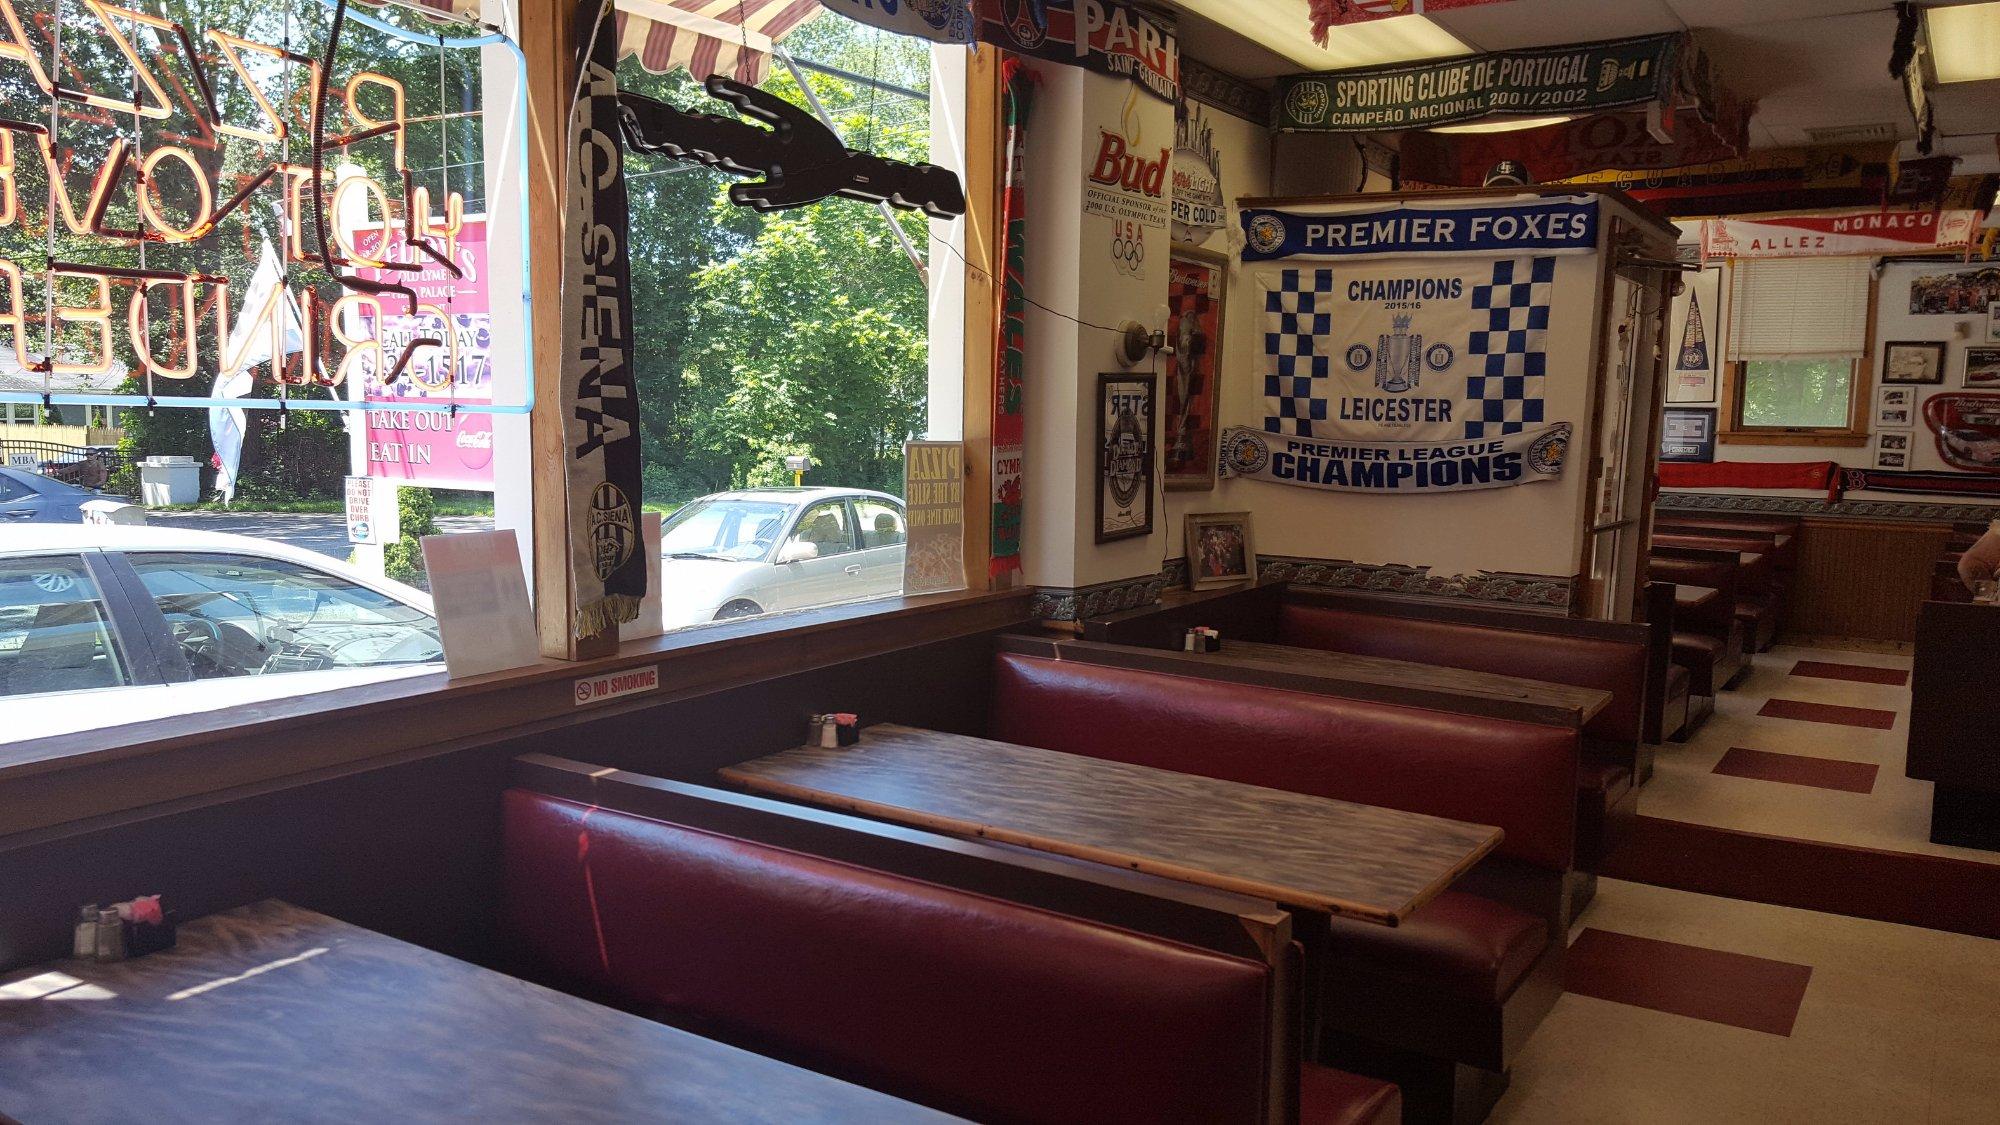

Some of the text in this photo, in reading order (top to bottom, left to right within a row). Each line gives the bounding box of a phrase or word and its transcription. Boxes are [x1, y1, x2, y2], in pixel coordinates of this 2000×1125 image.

[1106, 52, 1174, 100] SAINT-GERMAIN
[1337, 74, 1415, 107] SPORTING
[1418, 65, 1471, 100] CLUBE
[1473, 59, 1497, 91] DE
[1498, 53, 1590, 87] PORTUGAL
[1332, 107, 1404, 125] CAMPEÃO
[1409, 97, 1484, 120] NACIONAL
[1489, 88, 1588, 107] 2001/2002
[1089, 127, 1173, 198] Bud
[1087, 190, 1120, 204] OFFICIAL
[1121, 198, 1152, 211] SPONSOR
[1086, 201, 1167, 226] 2000 U.S. OLYMPIC TEAM
[1193, 206, 1217, 225] COLD
[1833, 213, 1933, 232] MONACO
[362, 231, 379, 247] OPEN
[1305, 218, 1456, 247] PREMIER
[1469, 212, 1588, 242] FOXES
[1751, 237, 1825, 250] ALLEZ
[398, 269, 447, 282] OLD LYME
[420, 285, 457, 299] PALACE
[1347, 277, 1463, 302] CHAMPIONS
[1384, 302, 1421, 310] 2015/16
[1340, 397, 1453, 422] LEICESTER
[367, 409, 454, 432] TAKE OUT
[12, 456, 35, 465] MBA
[369, 442, 433, 465] EAT IN
[1287, 441, 1391, 461] PREMIER
[1399, 440, 1504, 461] LEAGUE
[1271, 451, 1522, 488] CHAMPIONS
[346, 488, 371, 497] DO NOT
[349, 497, 369, 505] DRIVE
[350, 505, 369, 514] OVER
[593, 670, 656, 698] NO SMOKING
